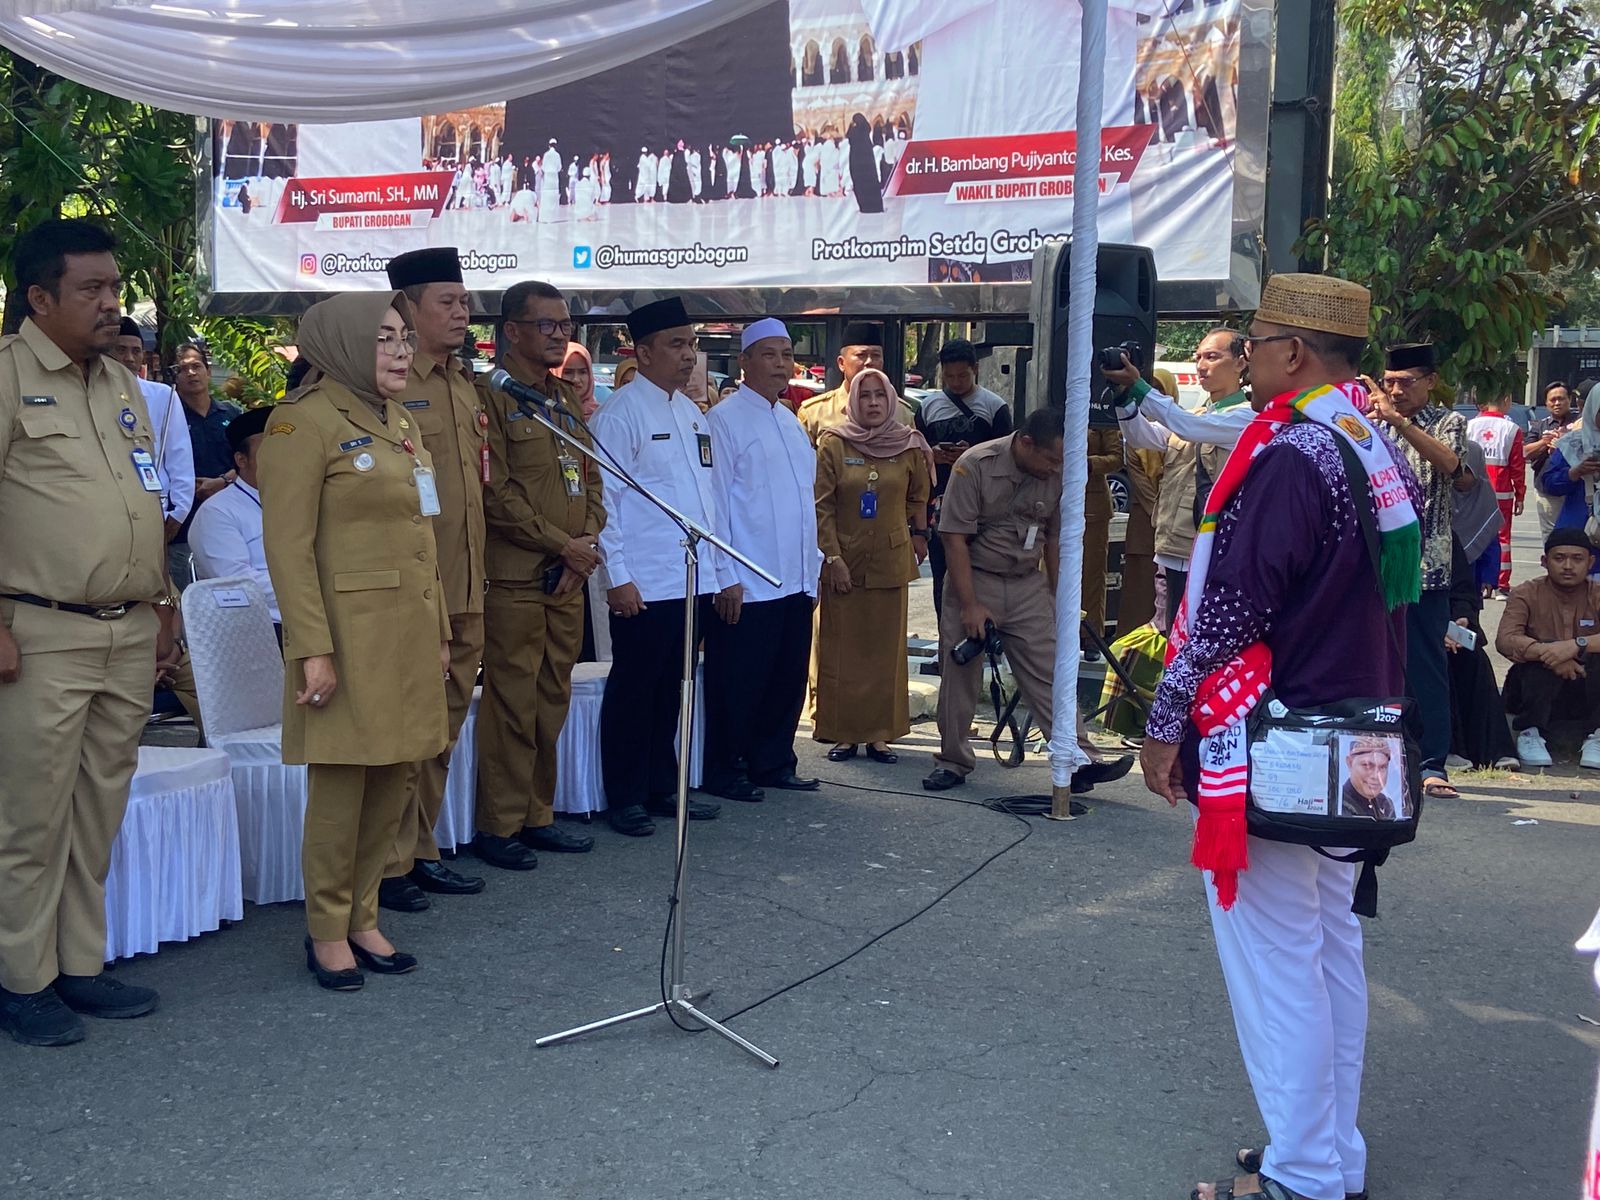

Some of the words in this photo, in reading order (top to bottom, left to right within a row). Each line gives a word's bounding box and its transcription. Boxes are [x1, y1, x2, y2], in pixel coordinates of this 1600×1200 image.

[905, 157, 923, 174] dr.
[924, 157, 939, 173] H.
[941, 154, 1009, 173] Bambang
[1104, 145, 1134, 162] Kes.
[291, 190, 308, 210] Hj.
[310, 189, 326, 204] Sri
[328, 186, 384, 205] Sumarni,
[386, 186, 411, 203] SH.,
[413, 184, 439, 201] MM
[955, 183, 993, 201] WAKIL
[995, 181, 1037, 199] BUPATI
[1039, 177, 1106, 197] GROBN
[332, 216, 362, 229] BUPATI
[364, 214, 411, 228] GROBOGAN
[596, 242, 748, 269] @humasgrobogan
[812, 234, 925, 262] Protkompim
[928, 230, 987, 256] Setda
[1483, 447, 1496, 458] MI
